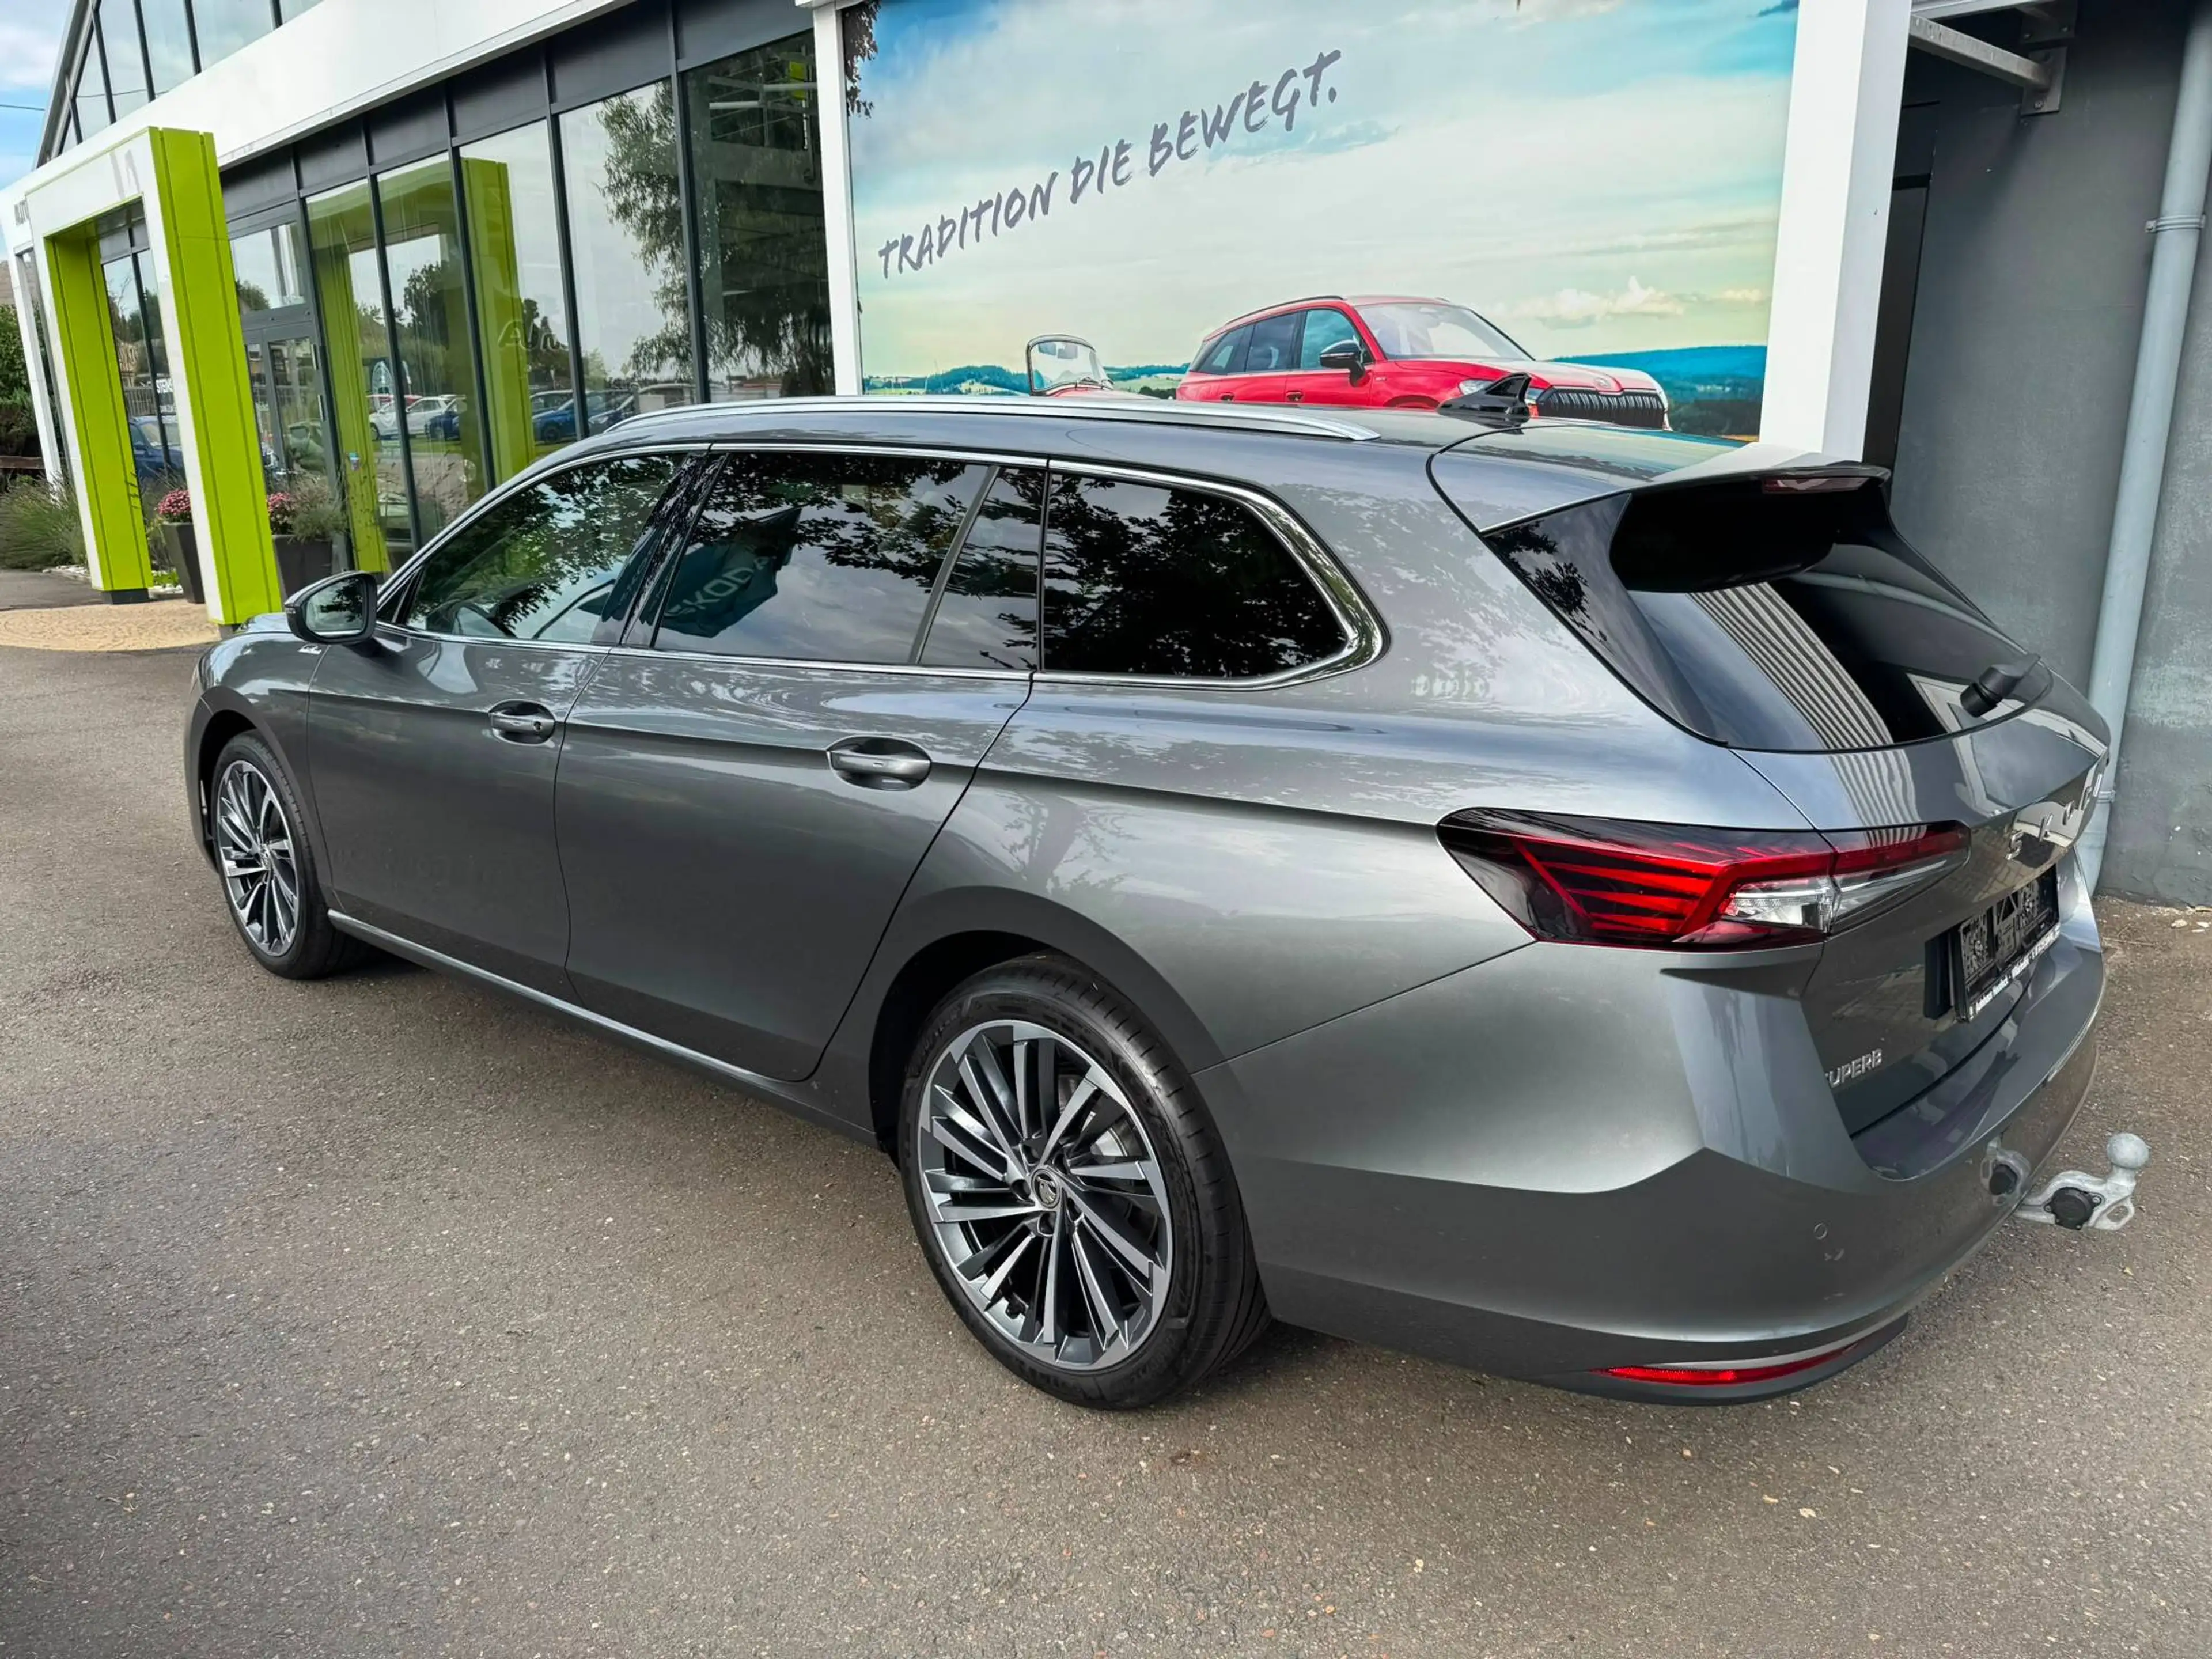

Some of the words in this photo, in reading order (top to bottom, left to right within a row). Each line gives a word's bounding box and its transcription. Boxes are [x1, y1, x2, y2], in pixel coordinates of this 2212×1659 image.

[878, 171, 1059, 279] TRADITION
[1070, 139, 1134, 204] DIE
[1148, 49, 1342, 177] BEWEGT.
[1825, 1048, 1883, 1088] UPERB
